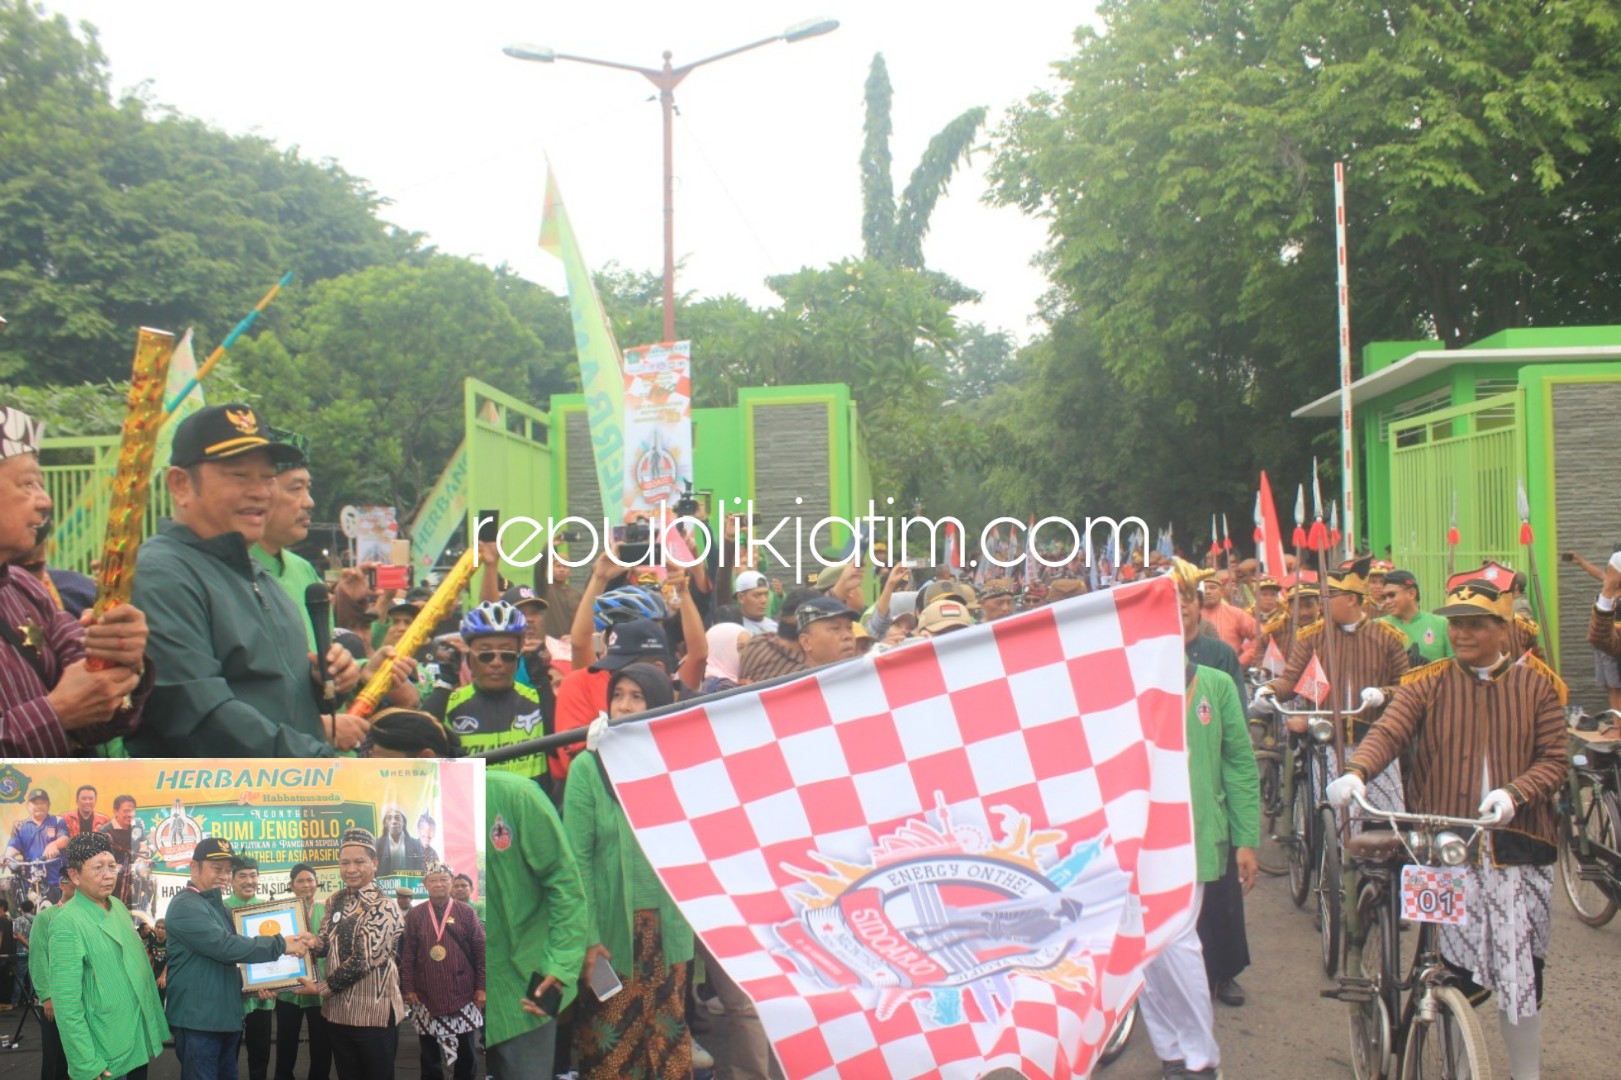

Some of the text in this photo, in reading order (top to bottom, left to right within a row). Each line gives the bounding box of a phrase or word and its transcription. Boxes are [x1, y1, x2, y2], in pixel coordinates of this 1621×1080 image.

[156, 767, 335, 790] HERBANGIN
[211, 821, 254, 840] BUMI
[259, 819, 340, 840] JENGGOLO
[276, 850, 286, 863] OF
[887, 863, 1033, 896] ENERGY ONTHEL
[1418, 888, 1454, 916] 01
